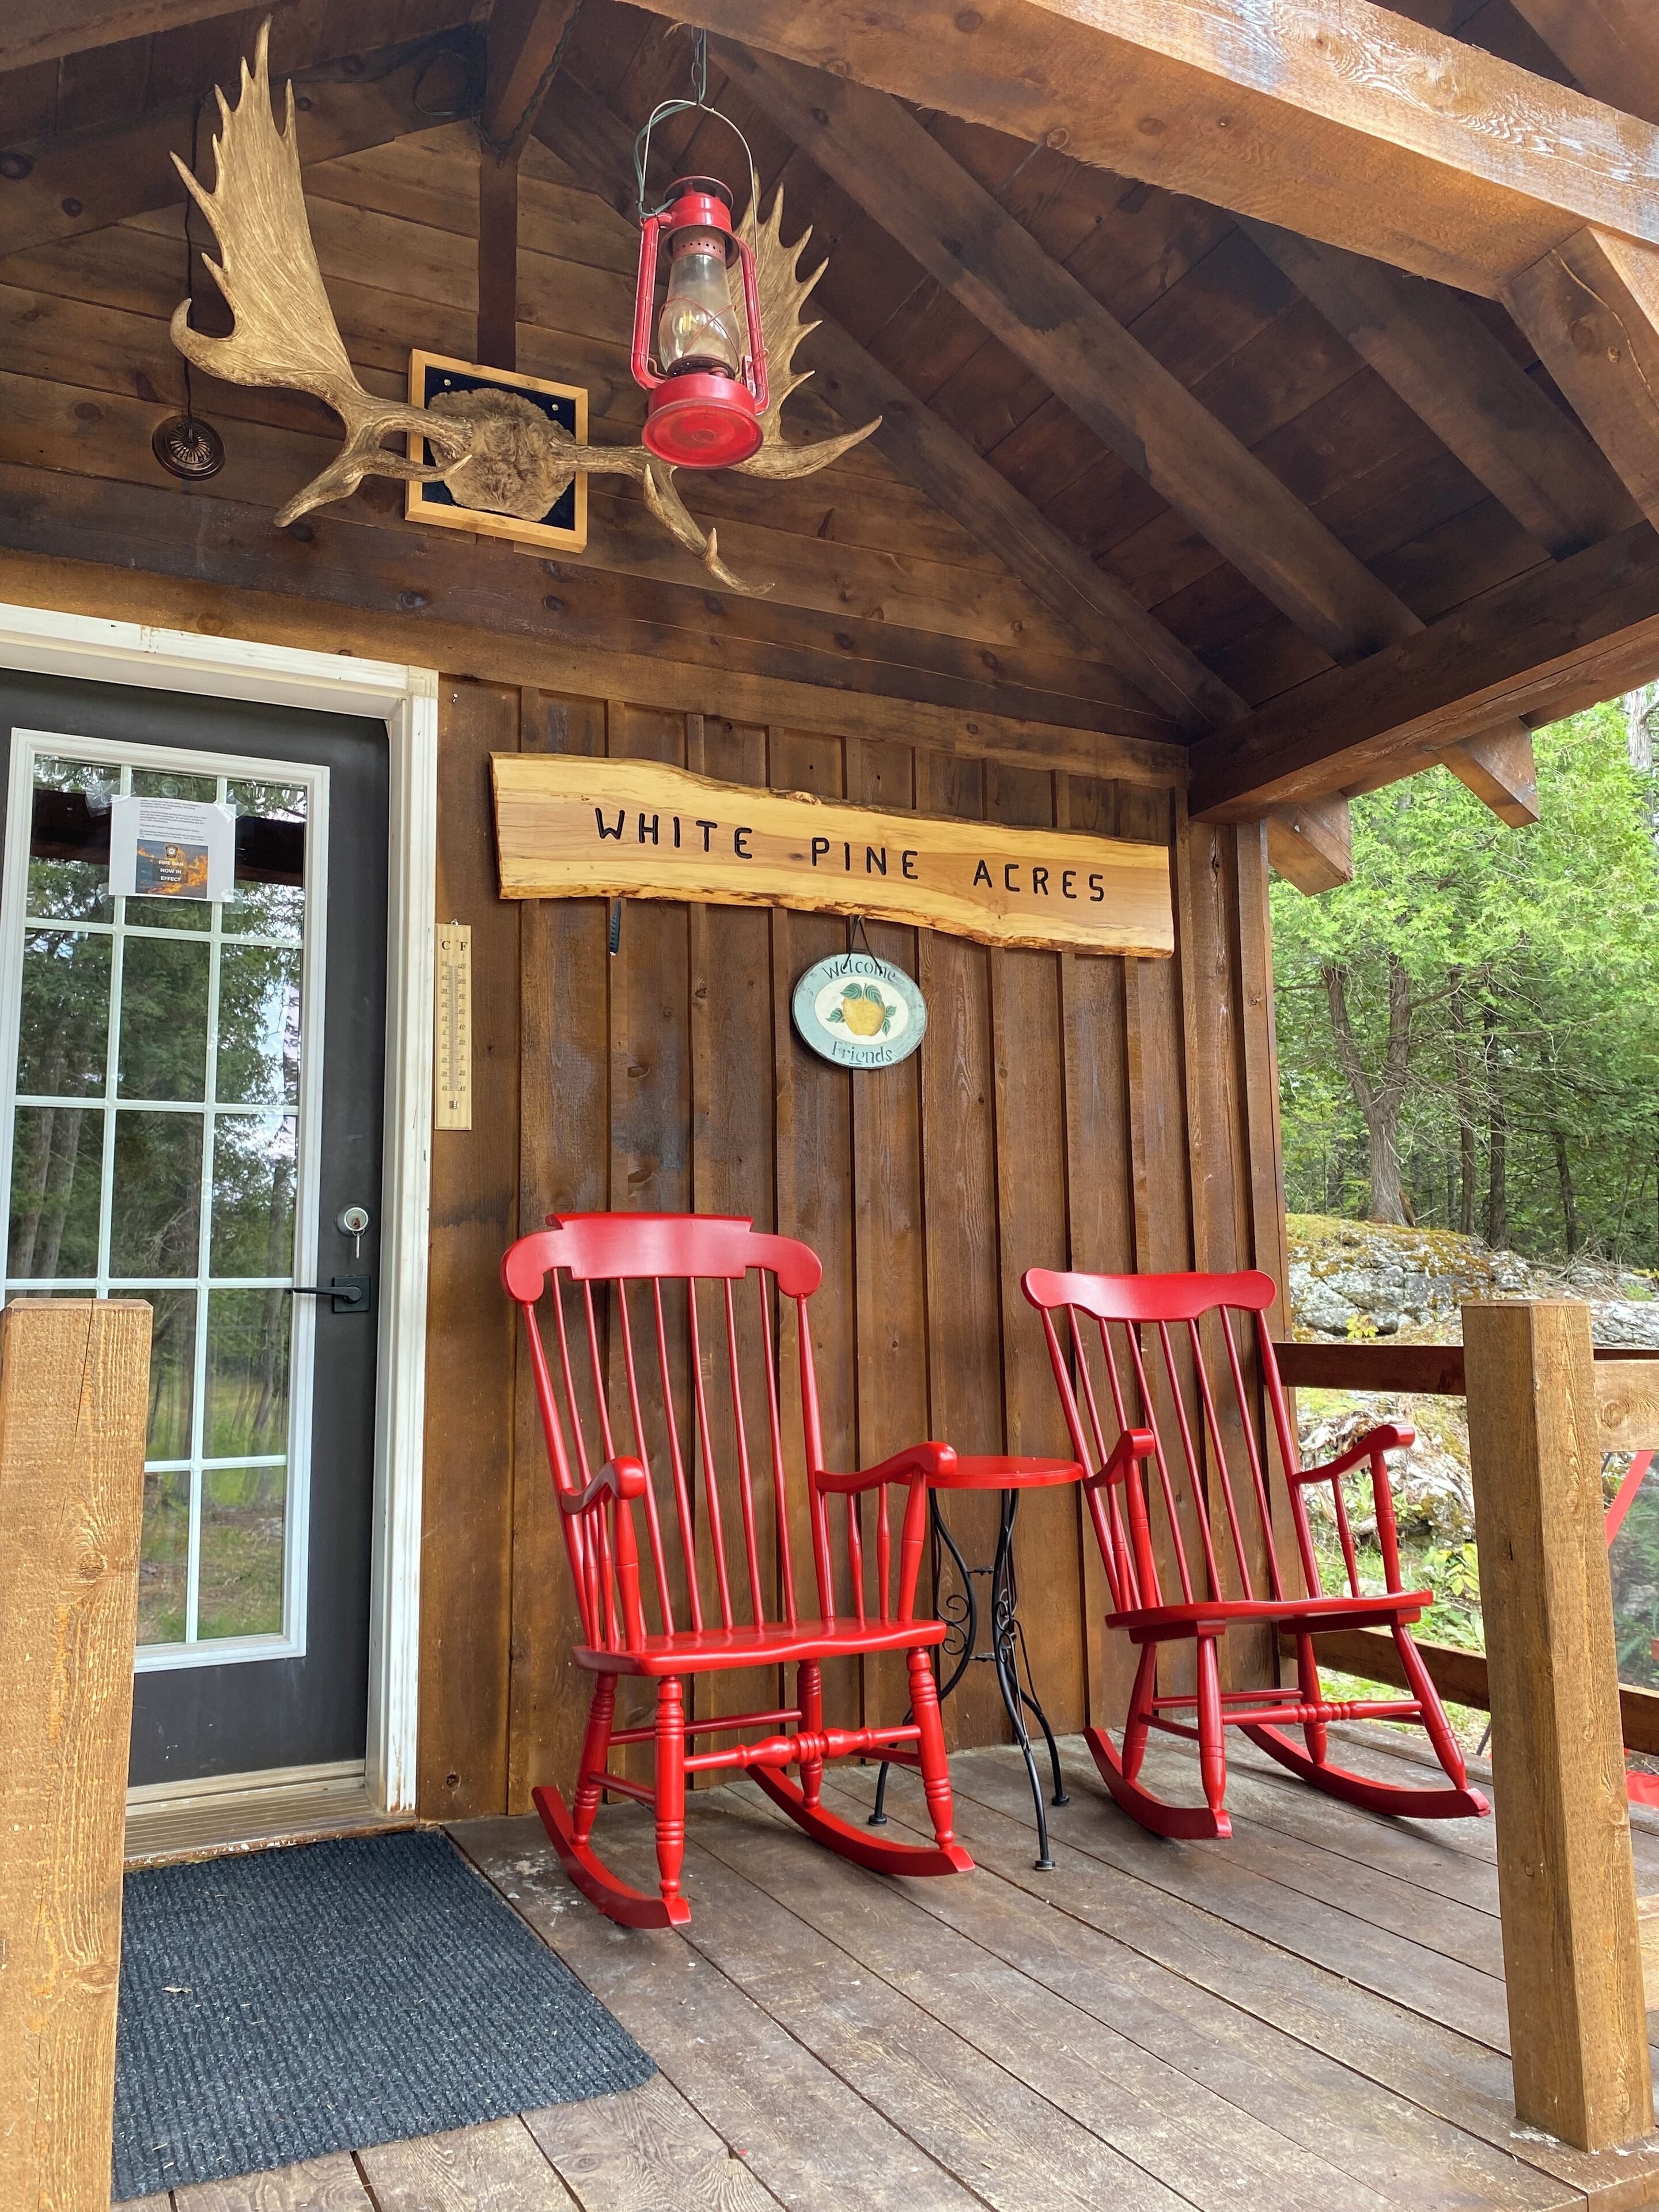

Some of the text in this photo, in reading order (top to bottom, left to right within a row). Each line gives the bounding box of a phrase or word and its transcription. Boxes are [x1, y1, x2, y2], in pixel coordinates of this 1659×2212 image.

[594, 806, 1105, 903] WHITE PINE ACRES
[821, 959, 896, 982] Welcome
[831, 1041, 893, 1063] Friends
